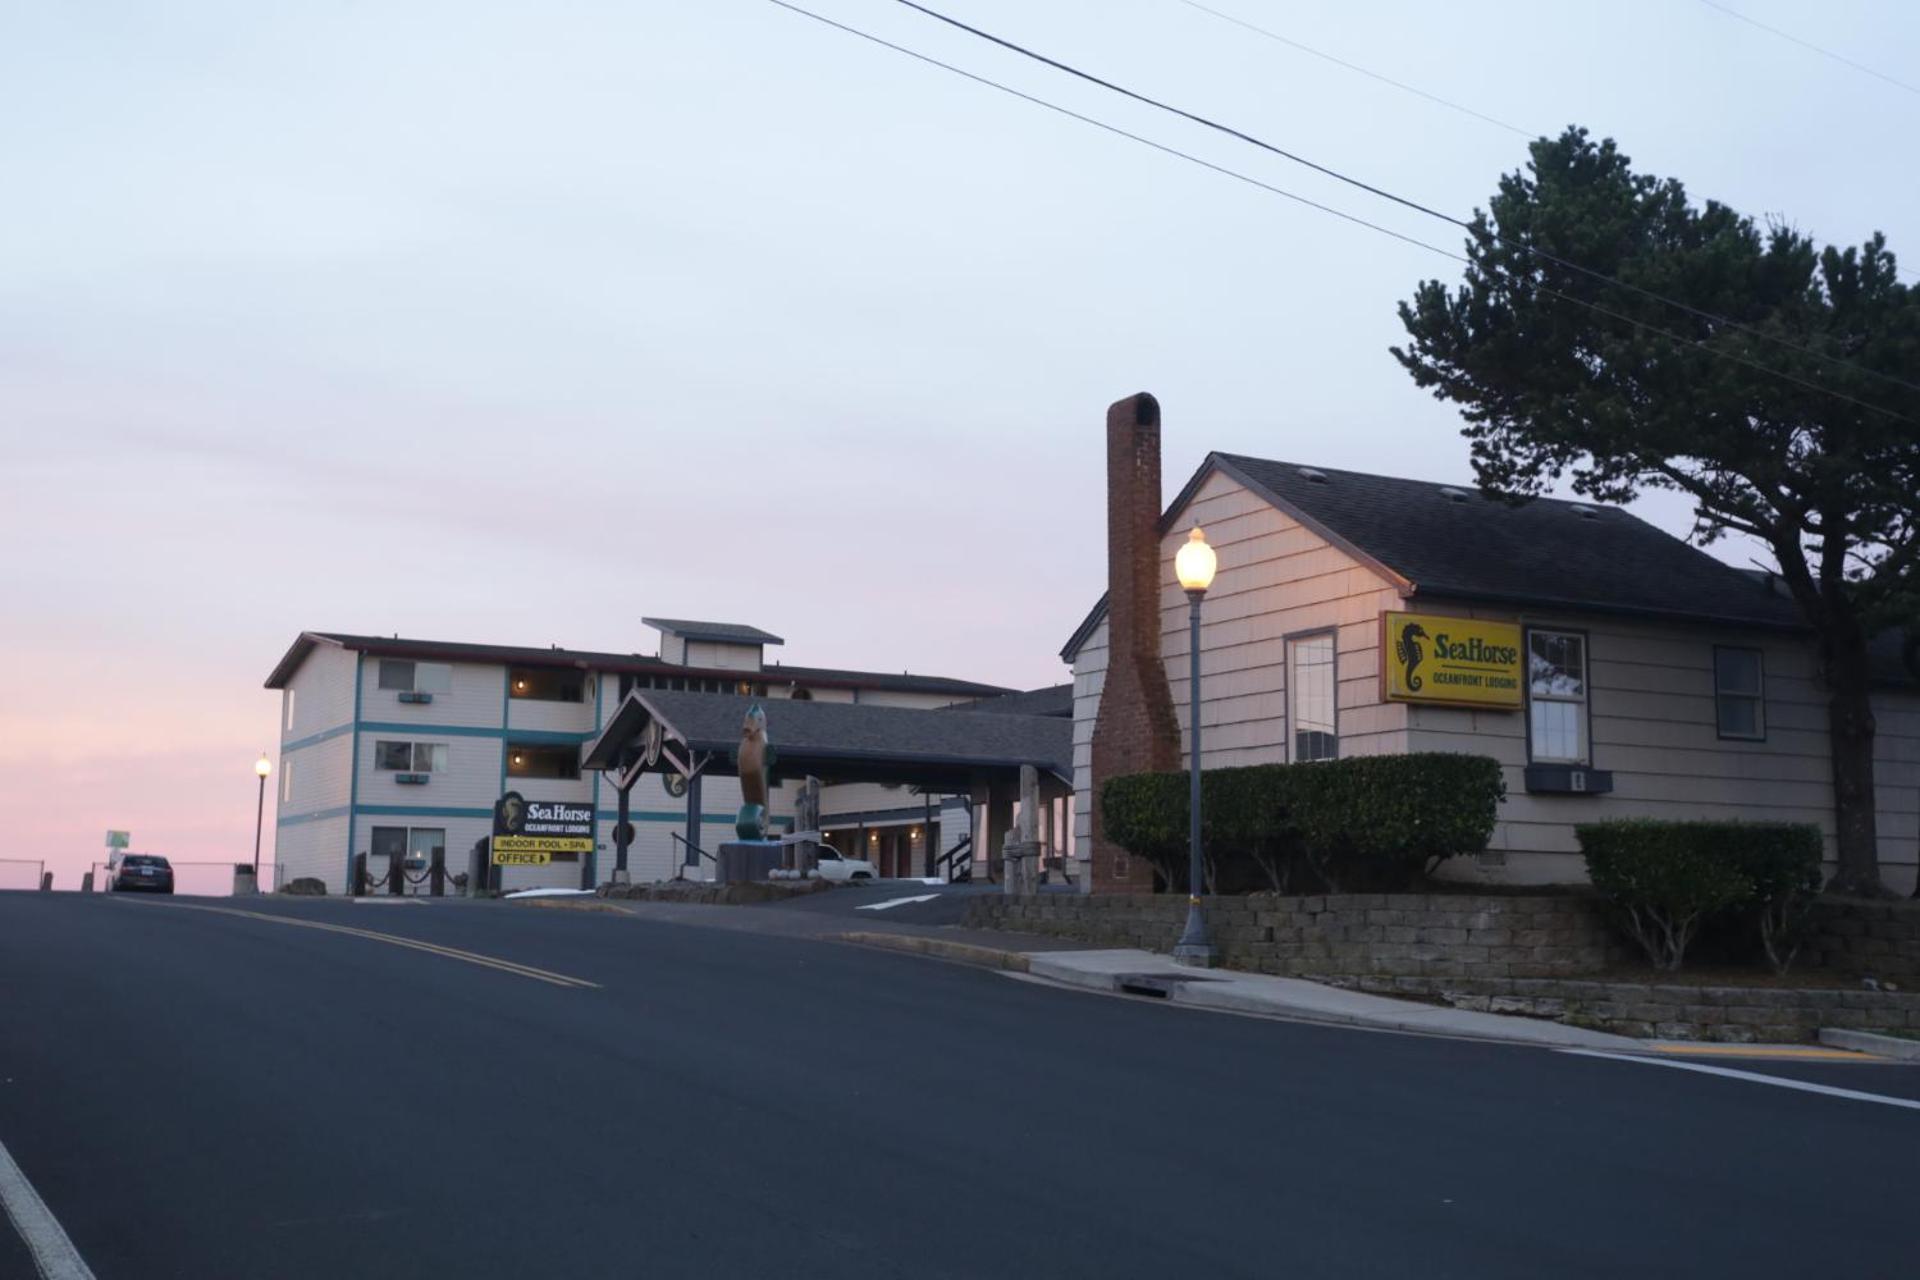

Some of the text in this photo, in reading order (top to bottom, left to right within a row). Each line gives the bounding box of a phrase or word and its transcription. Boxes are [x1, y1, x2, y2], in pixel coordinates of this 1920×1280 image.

[1434, 634, 1517, 665] SeaHorse
[1433, 672, 1482, 688] OCEANFRONT
[501, 839, 586, 849] INDOOR POOL SPA
[497, 853, 537, 863] OFFICE
